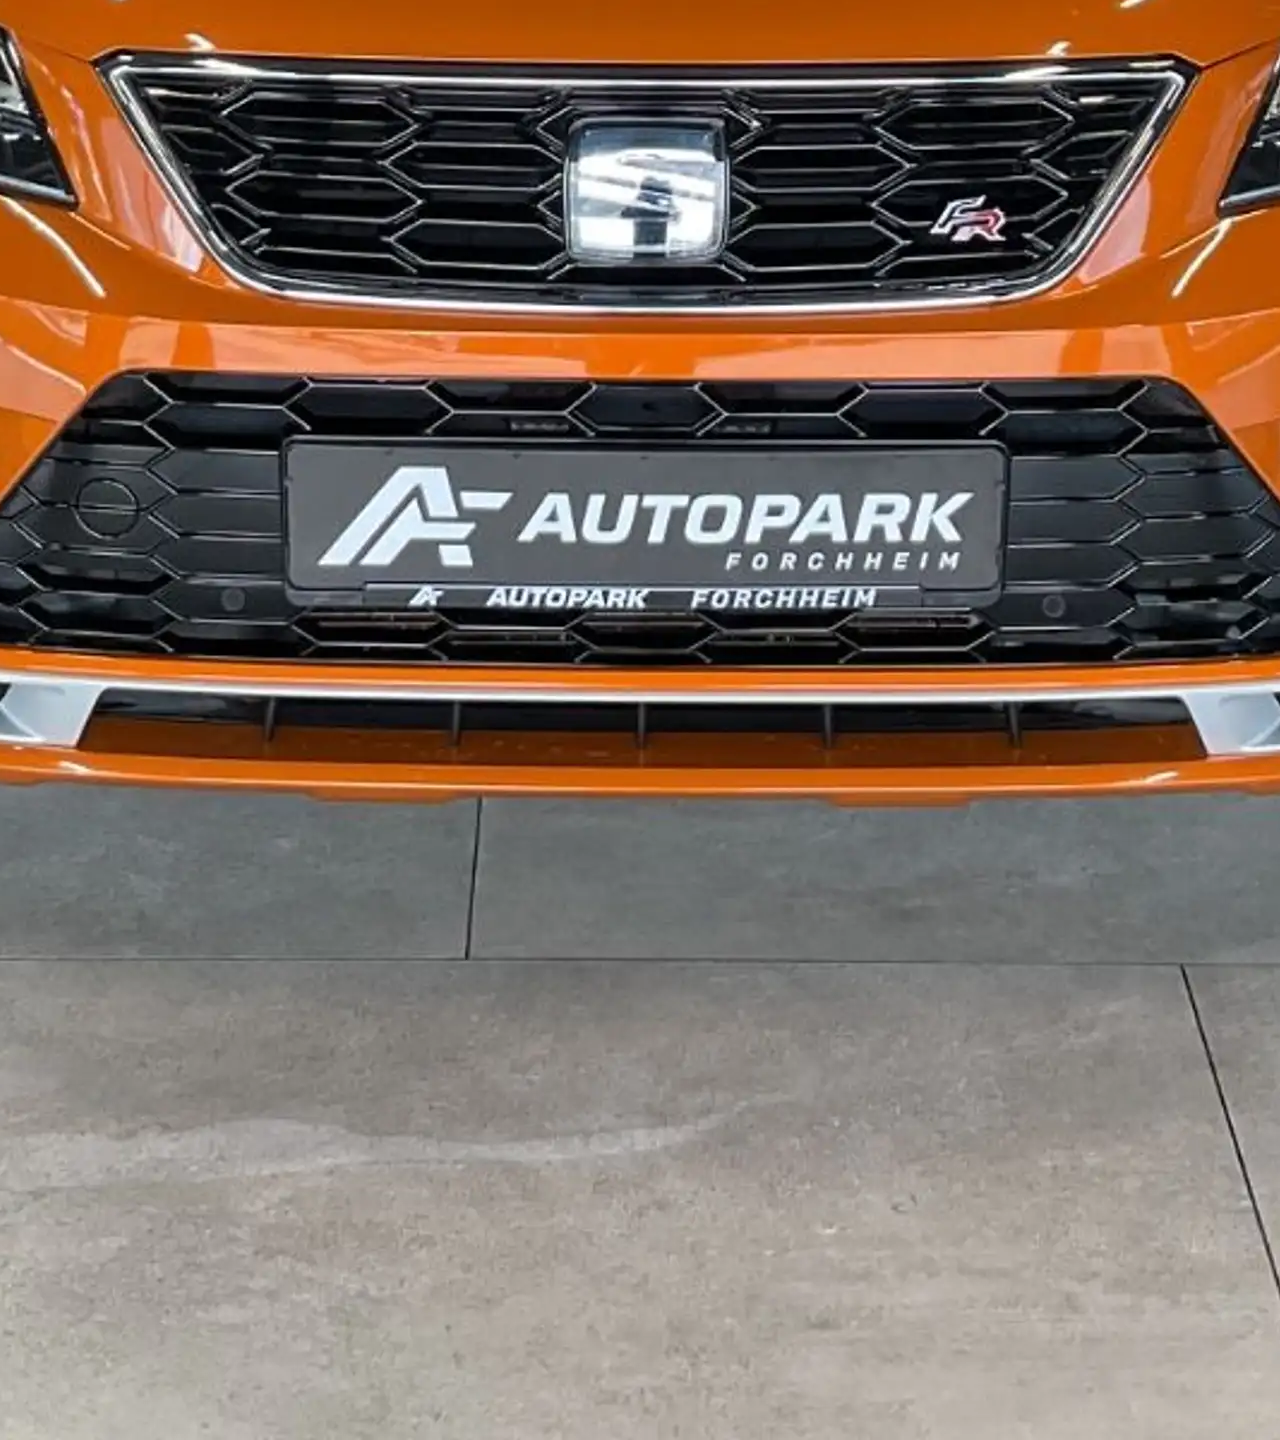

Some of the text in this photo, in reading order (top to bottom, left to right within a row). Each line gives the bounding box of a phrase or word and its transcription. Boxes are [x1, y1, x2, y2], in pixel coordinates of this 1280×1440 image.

[929, 194, 1007, 242] FR
[517, 492, 975, 545] AUTOPARK
[725, 551, 962, 572] FORCHHEIM
[486, 587, 652, 609] AUTOPARK
[690, 588, 878, 610] FORCHHEIM
